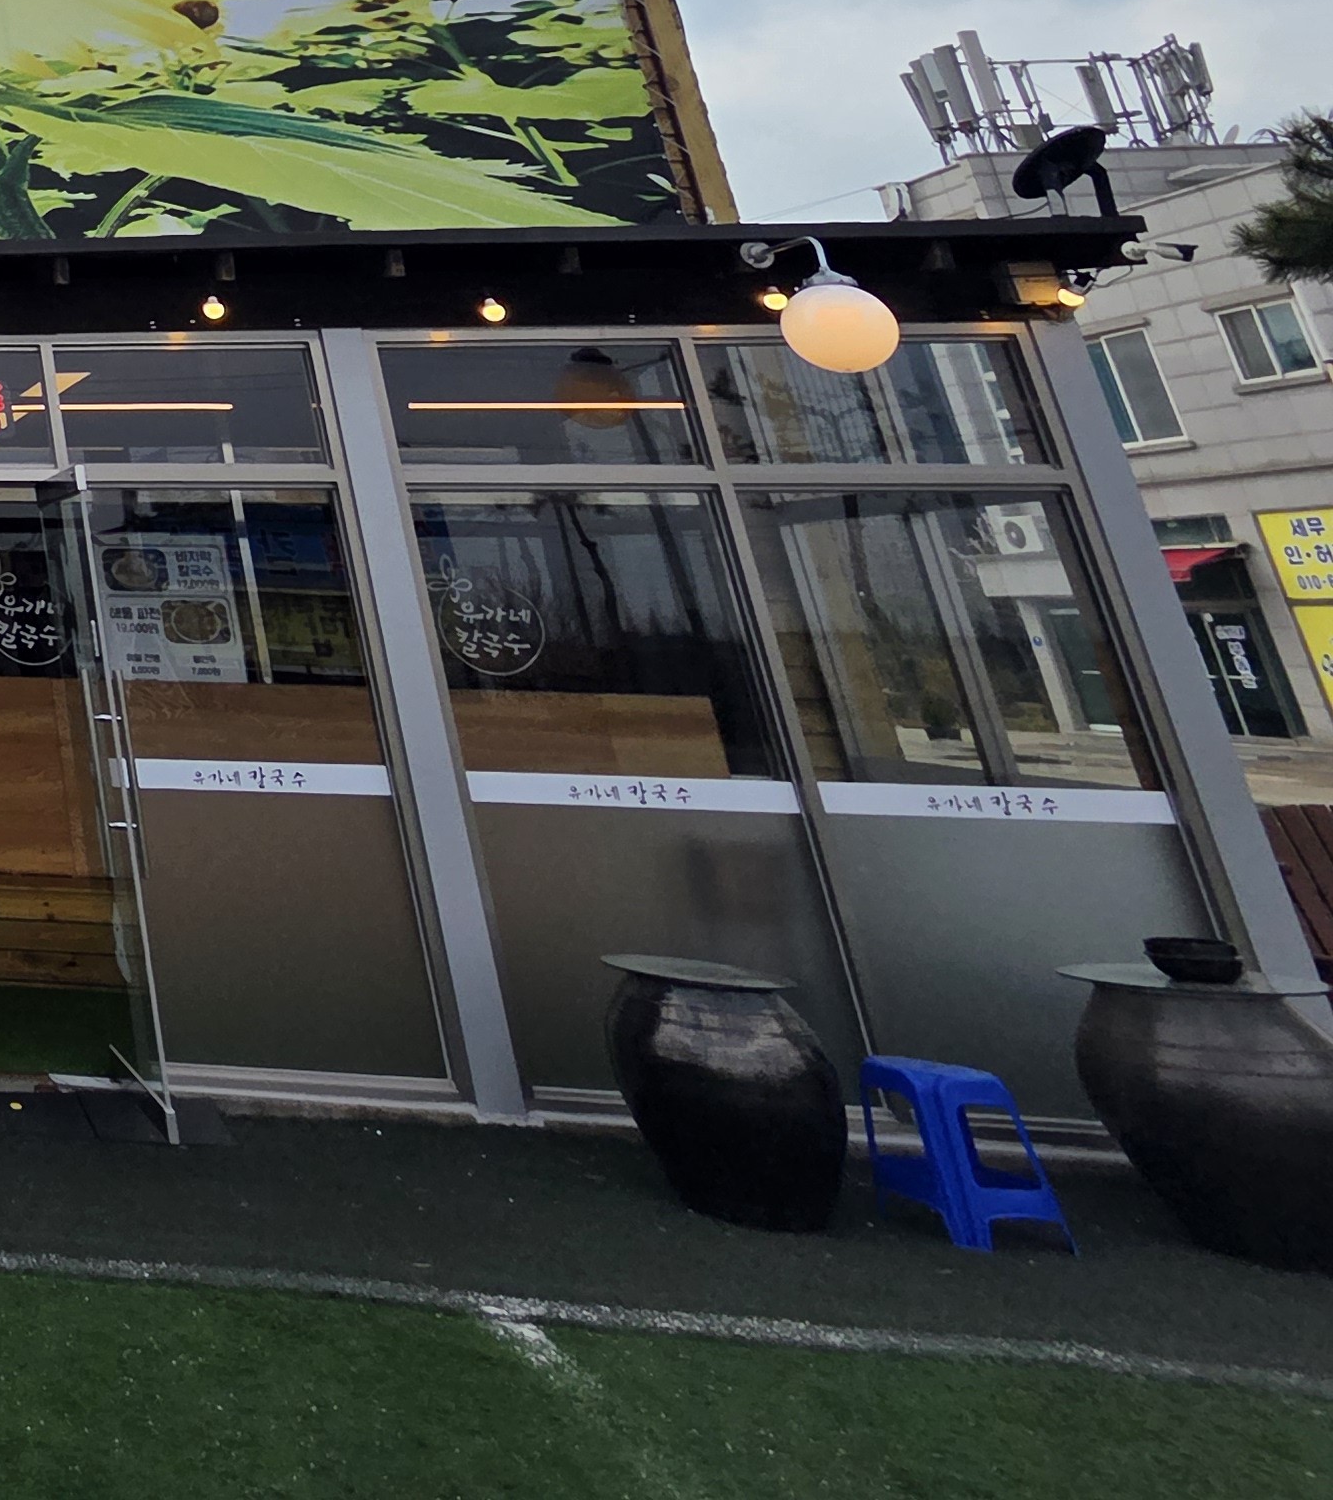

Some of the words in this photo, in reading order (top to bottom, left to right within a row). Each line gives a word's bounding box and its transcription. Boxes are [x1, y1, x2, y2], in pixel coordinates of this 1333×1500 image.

[1289, 516, 1326, 537] 세무
[1284, 544, 1333, 566] 인·허
[453, 601, 531, 624] 유가네
[455, 627, 531, 658] 칼국수
[193, 769, 241, 786] 유가네
[248, 766, 306, 789] 칼국수
[569, 784, 621, 801] 유가네
[628, 781, 692, 805] 칼국수
[927, 794, 983, 812] 유가네
[990, 791, 1058, 816] 칼국수
